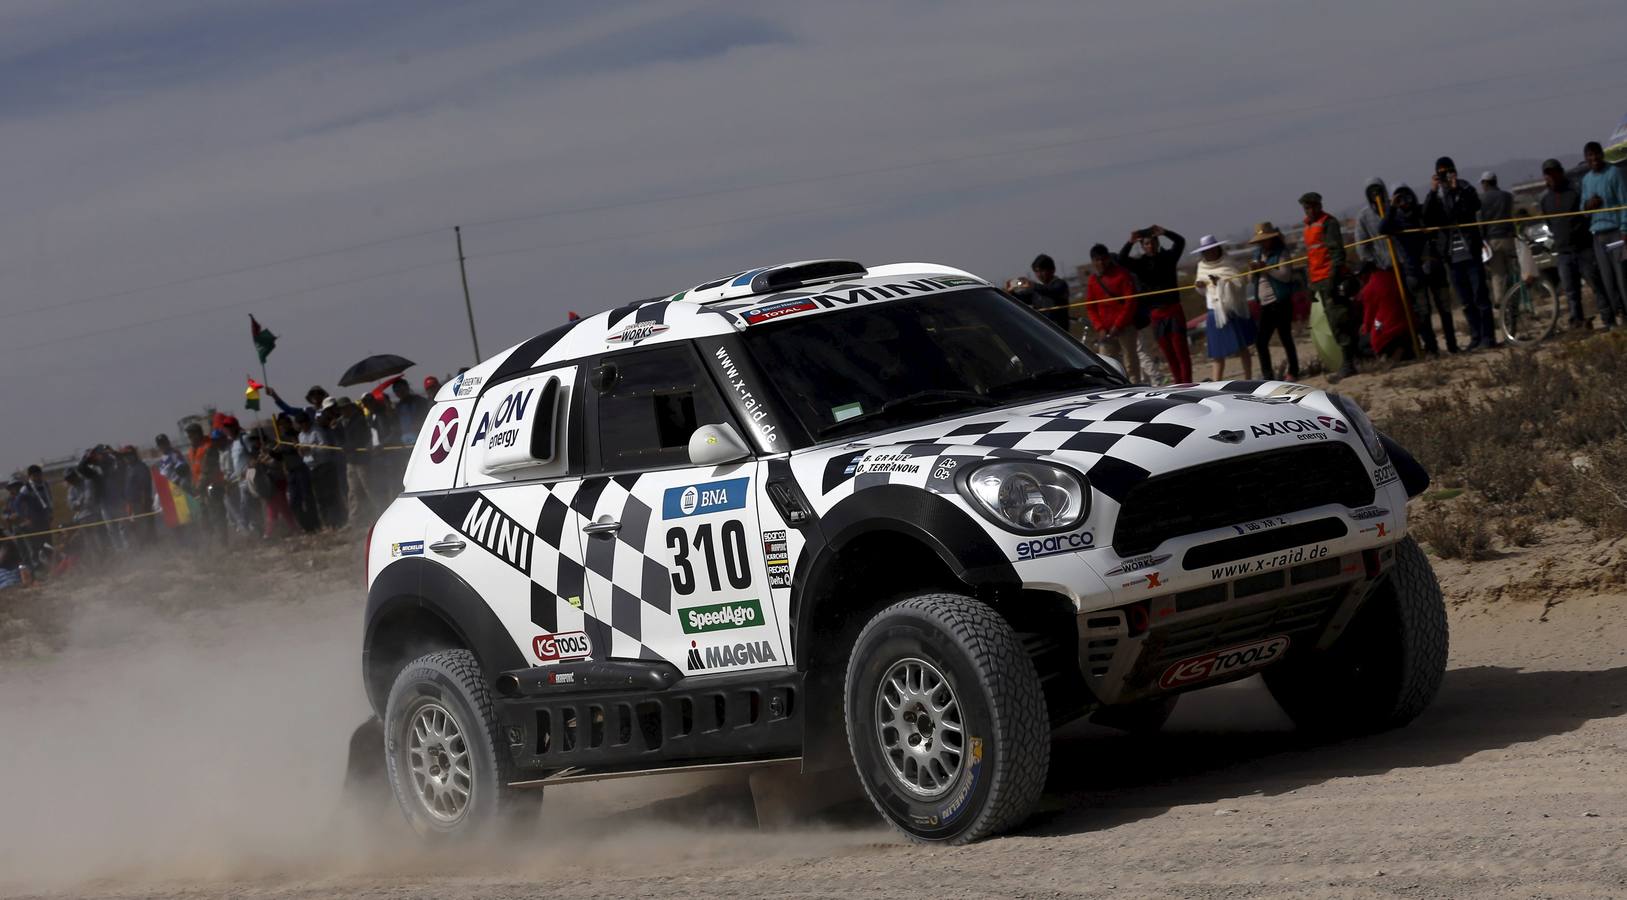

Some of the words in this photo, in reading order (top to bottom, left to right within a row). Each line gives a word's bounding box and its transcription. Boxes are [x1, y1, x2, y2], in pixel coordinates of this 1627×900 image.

[812, 278, 947, 308] MINI
[762, 307, 801, 318] TOTAL
[621, 326, 654, 341] WORKS
[715, 346, 777, 444] www.x-raid.de
[471, 388, 534, 447] AON
[488, 428, 520, 450] energy
[1250, 419, 1320, 439] AXION
[1297, 429, 1328, 441] energy
[868, 463, 920, 474] TERRANOVA
[700, 489, 728, 507] BNA
[461, 497, 530, 571] MINI
[764, 531, 786, 541] sparco
[1016, 531, 1094, 560] sparco
[665, 519, 752, 596] 310
[1122, 558, 1156, 572] WORKS
[1210, 545, 1328, 580] www.x-raid.de
[769, 565, 789, 574] RECARO
[688, 606, 755, 630] SpeedAgro
[554, 637, 588, 654] TOOLS
[705, 640, 777, 668] MAGNA
[1213, 641, 1280, 671] TOOLS
